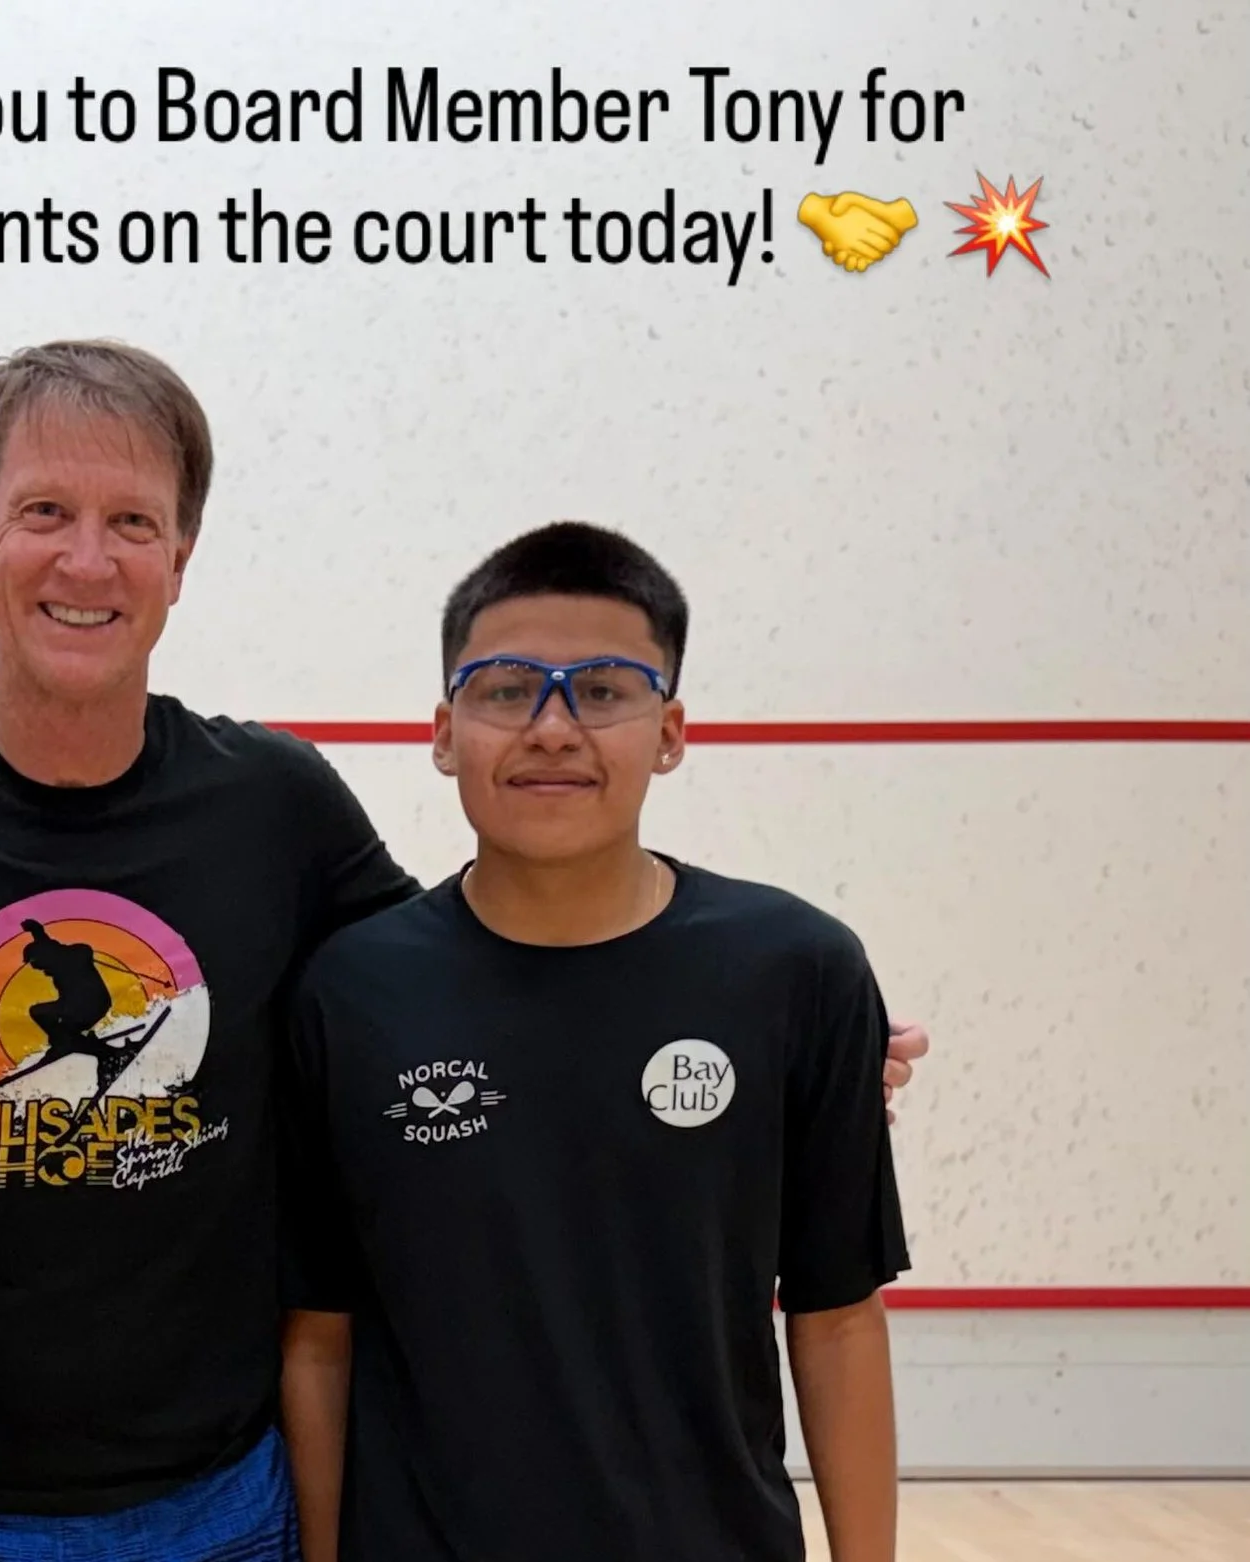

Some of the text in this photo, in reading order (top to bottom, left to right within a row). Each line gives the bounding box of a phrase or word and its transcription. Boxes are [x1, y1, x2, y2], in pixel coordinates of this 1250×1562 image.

[398, 1060, 489, 1089] NORCAL
[672, 1054, 731, 1089] Bay
[646, 1084, 718, 1112] Club
[116, 1116, 229, 1174] Spring Skiing
[124, 1125, 155, 1149] The
[403, 1115, 488, 1145] SQUASH
[112, 1151, 184, 1191] Capital
